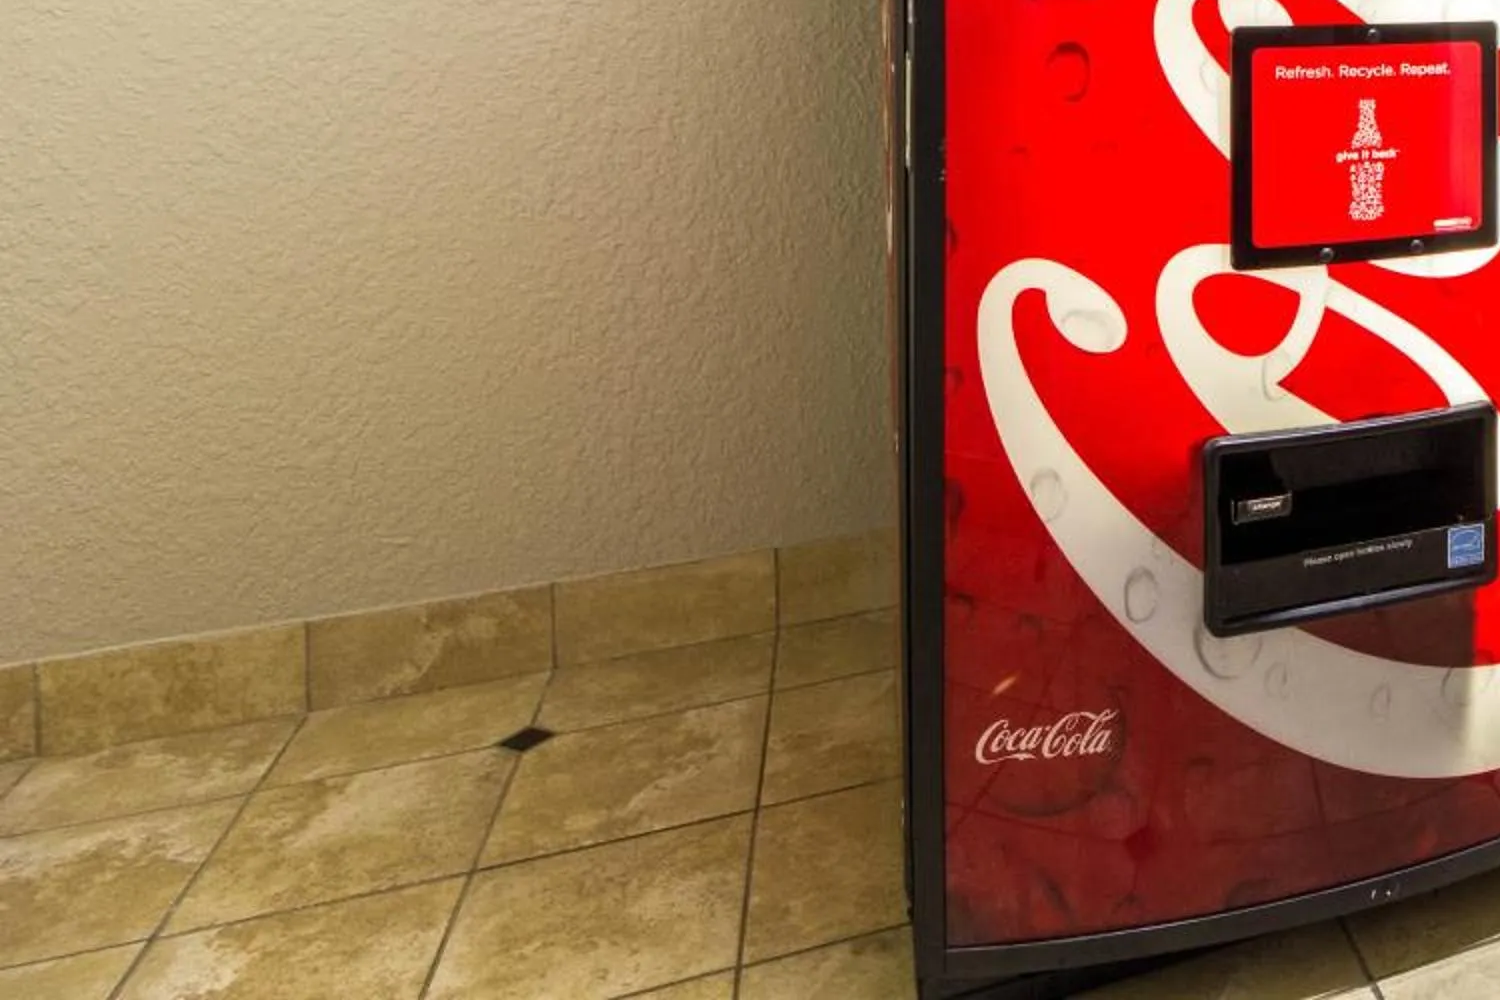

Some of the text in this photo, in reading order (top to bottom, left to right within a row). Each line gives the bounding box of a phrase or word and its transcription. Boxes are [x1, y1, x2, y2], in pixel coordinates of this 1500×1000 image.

[1275, 61, 1452, 80] Refresh. Recycle. Repeat.
[975, 709, 1119, 765] Coca-Cola
